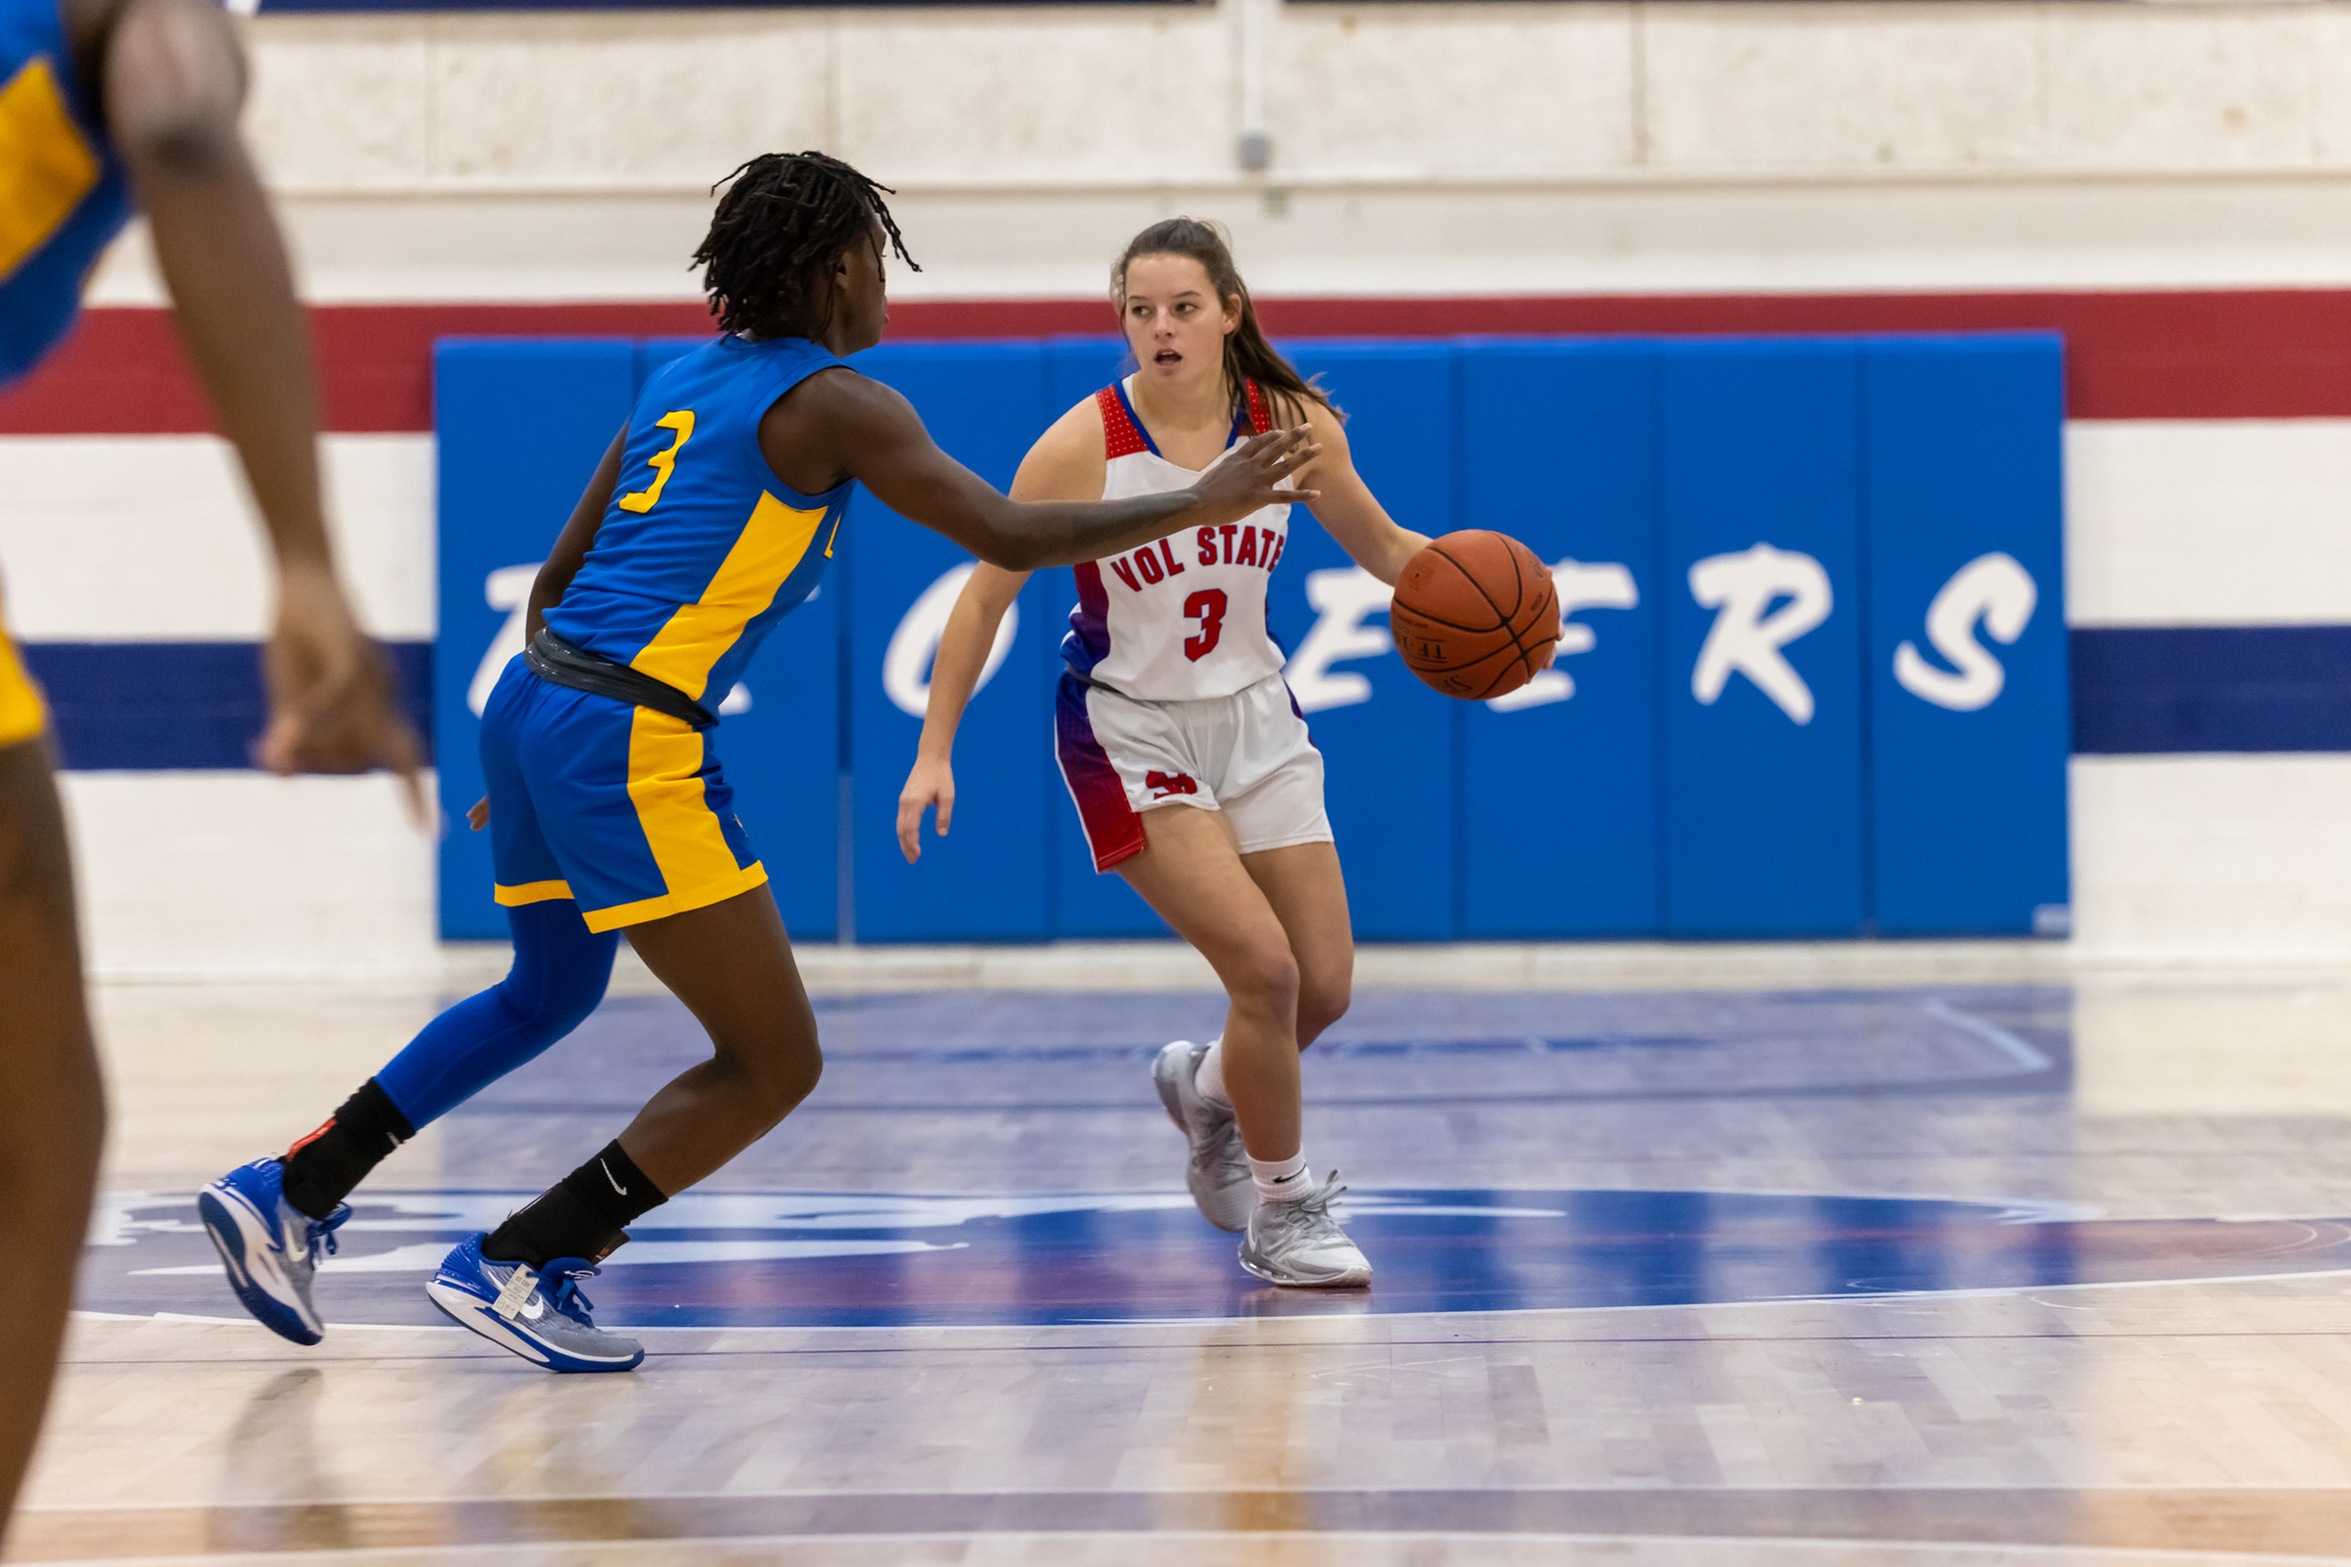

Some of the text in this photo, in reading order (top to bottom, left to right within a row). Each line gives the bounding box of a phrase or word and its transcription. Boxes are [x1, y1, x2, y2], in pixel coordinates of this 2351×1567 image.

[617, 408, 697, 515] 3
[1109, 523, 1286, 593] VOL STATE
[1183, 587, 1228, 663] 3
